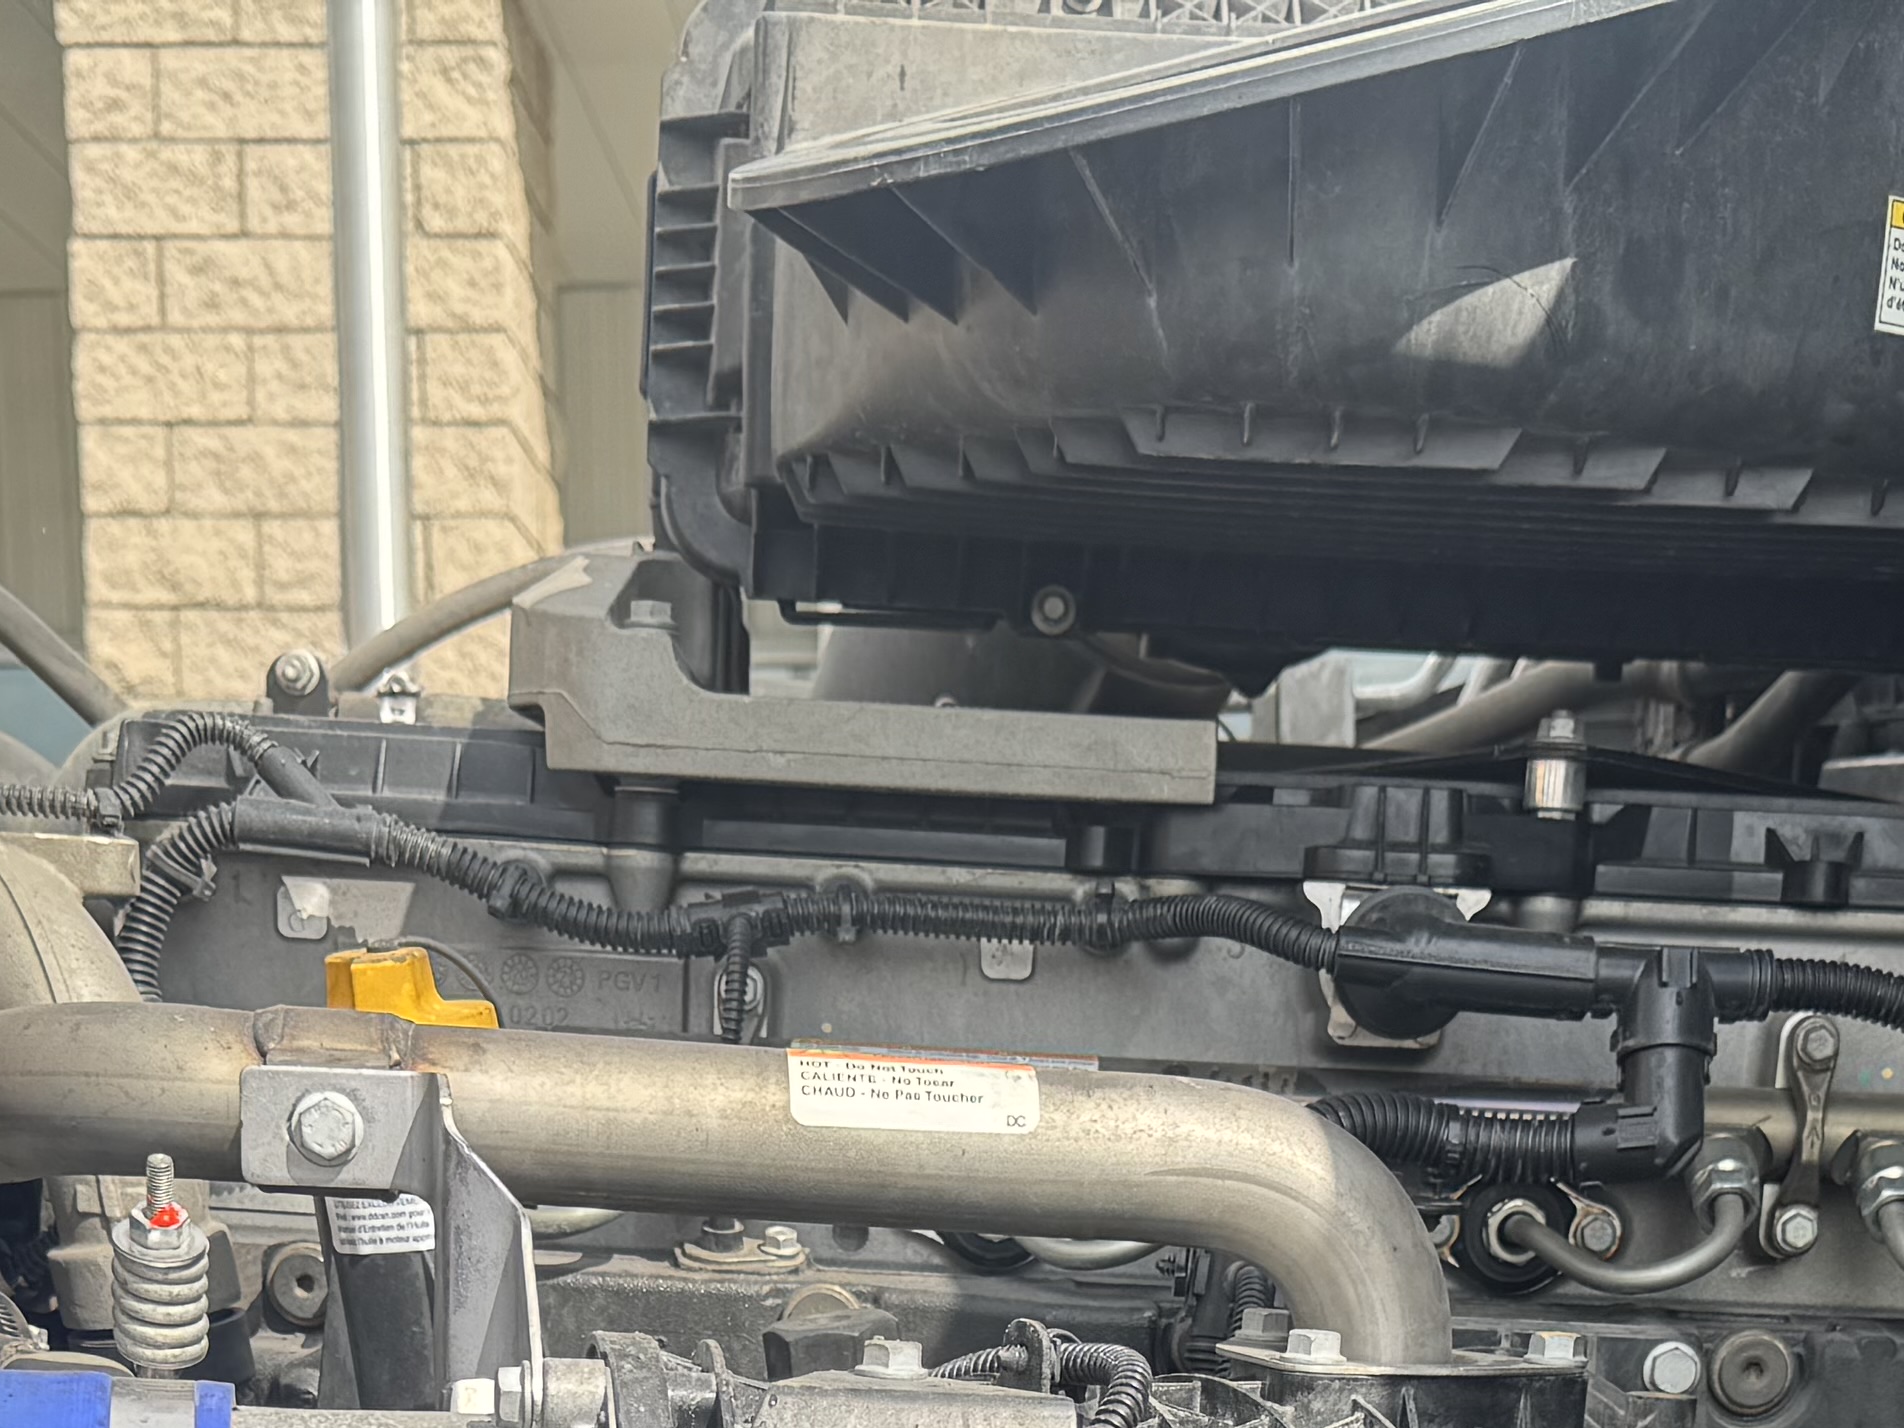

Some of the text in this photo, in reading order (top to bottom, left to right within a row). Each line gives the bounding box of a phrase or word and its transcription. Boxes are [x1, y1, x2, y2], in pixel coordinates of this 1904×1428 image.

[1891, 258, 1904, 272] No
[598, 970, 662, 993] PGV1
[801, 1072, 876, 1084] CALIENTE
[892, 1072, 910, 1085] No
[802, 1085, 855, 1098] CHAUD
[1007, 1115, 1026, 1127] DC
